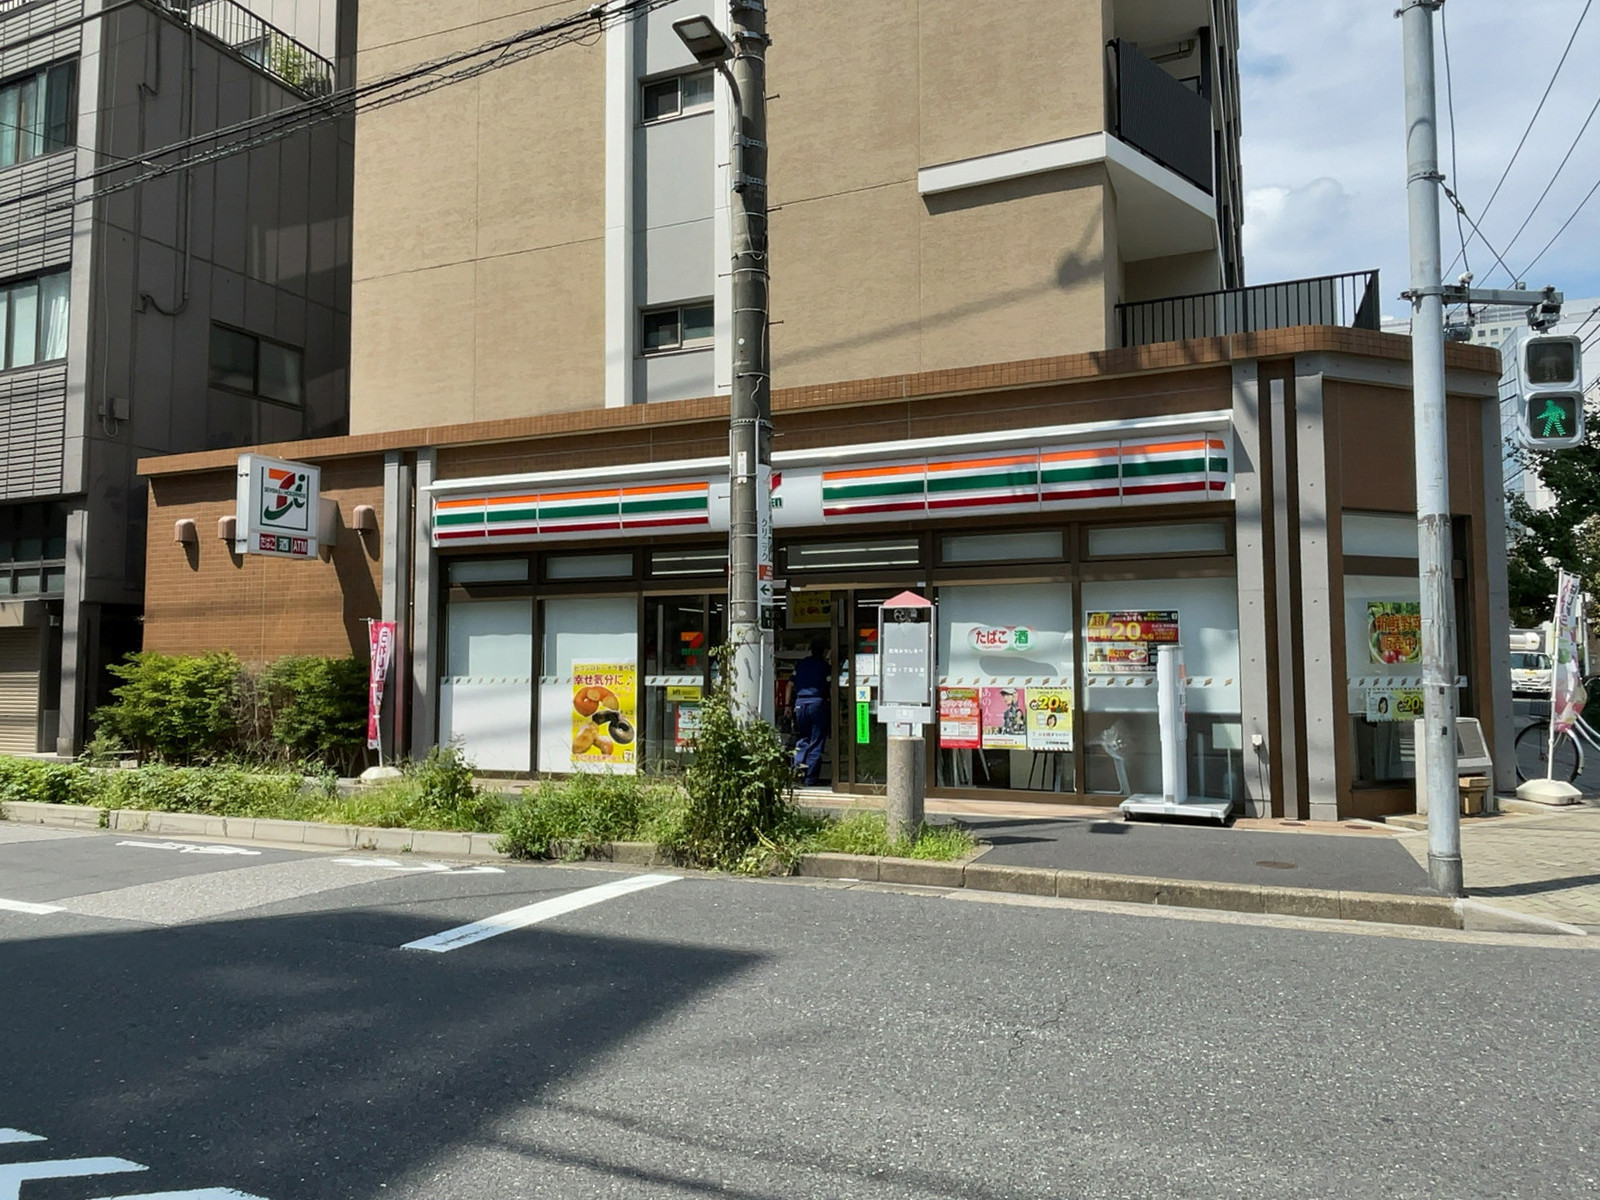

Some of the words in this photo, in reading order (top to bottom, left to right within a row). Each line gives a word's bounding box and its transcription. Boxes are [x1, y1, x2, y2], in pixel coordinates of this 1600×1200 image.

[293, 540, 307, 552] ATM
[760, 517, 769, 562] クリニック
[975, 629, 1008, 645] たばこ
[1014, 629, 1029, 645] 酒
